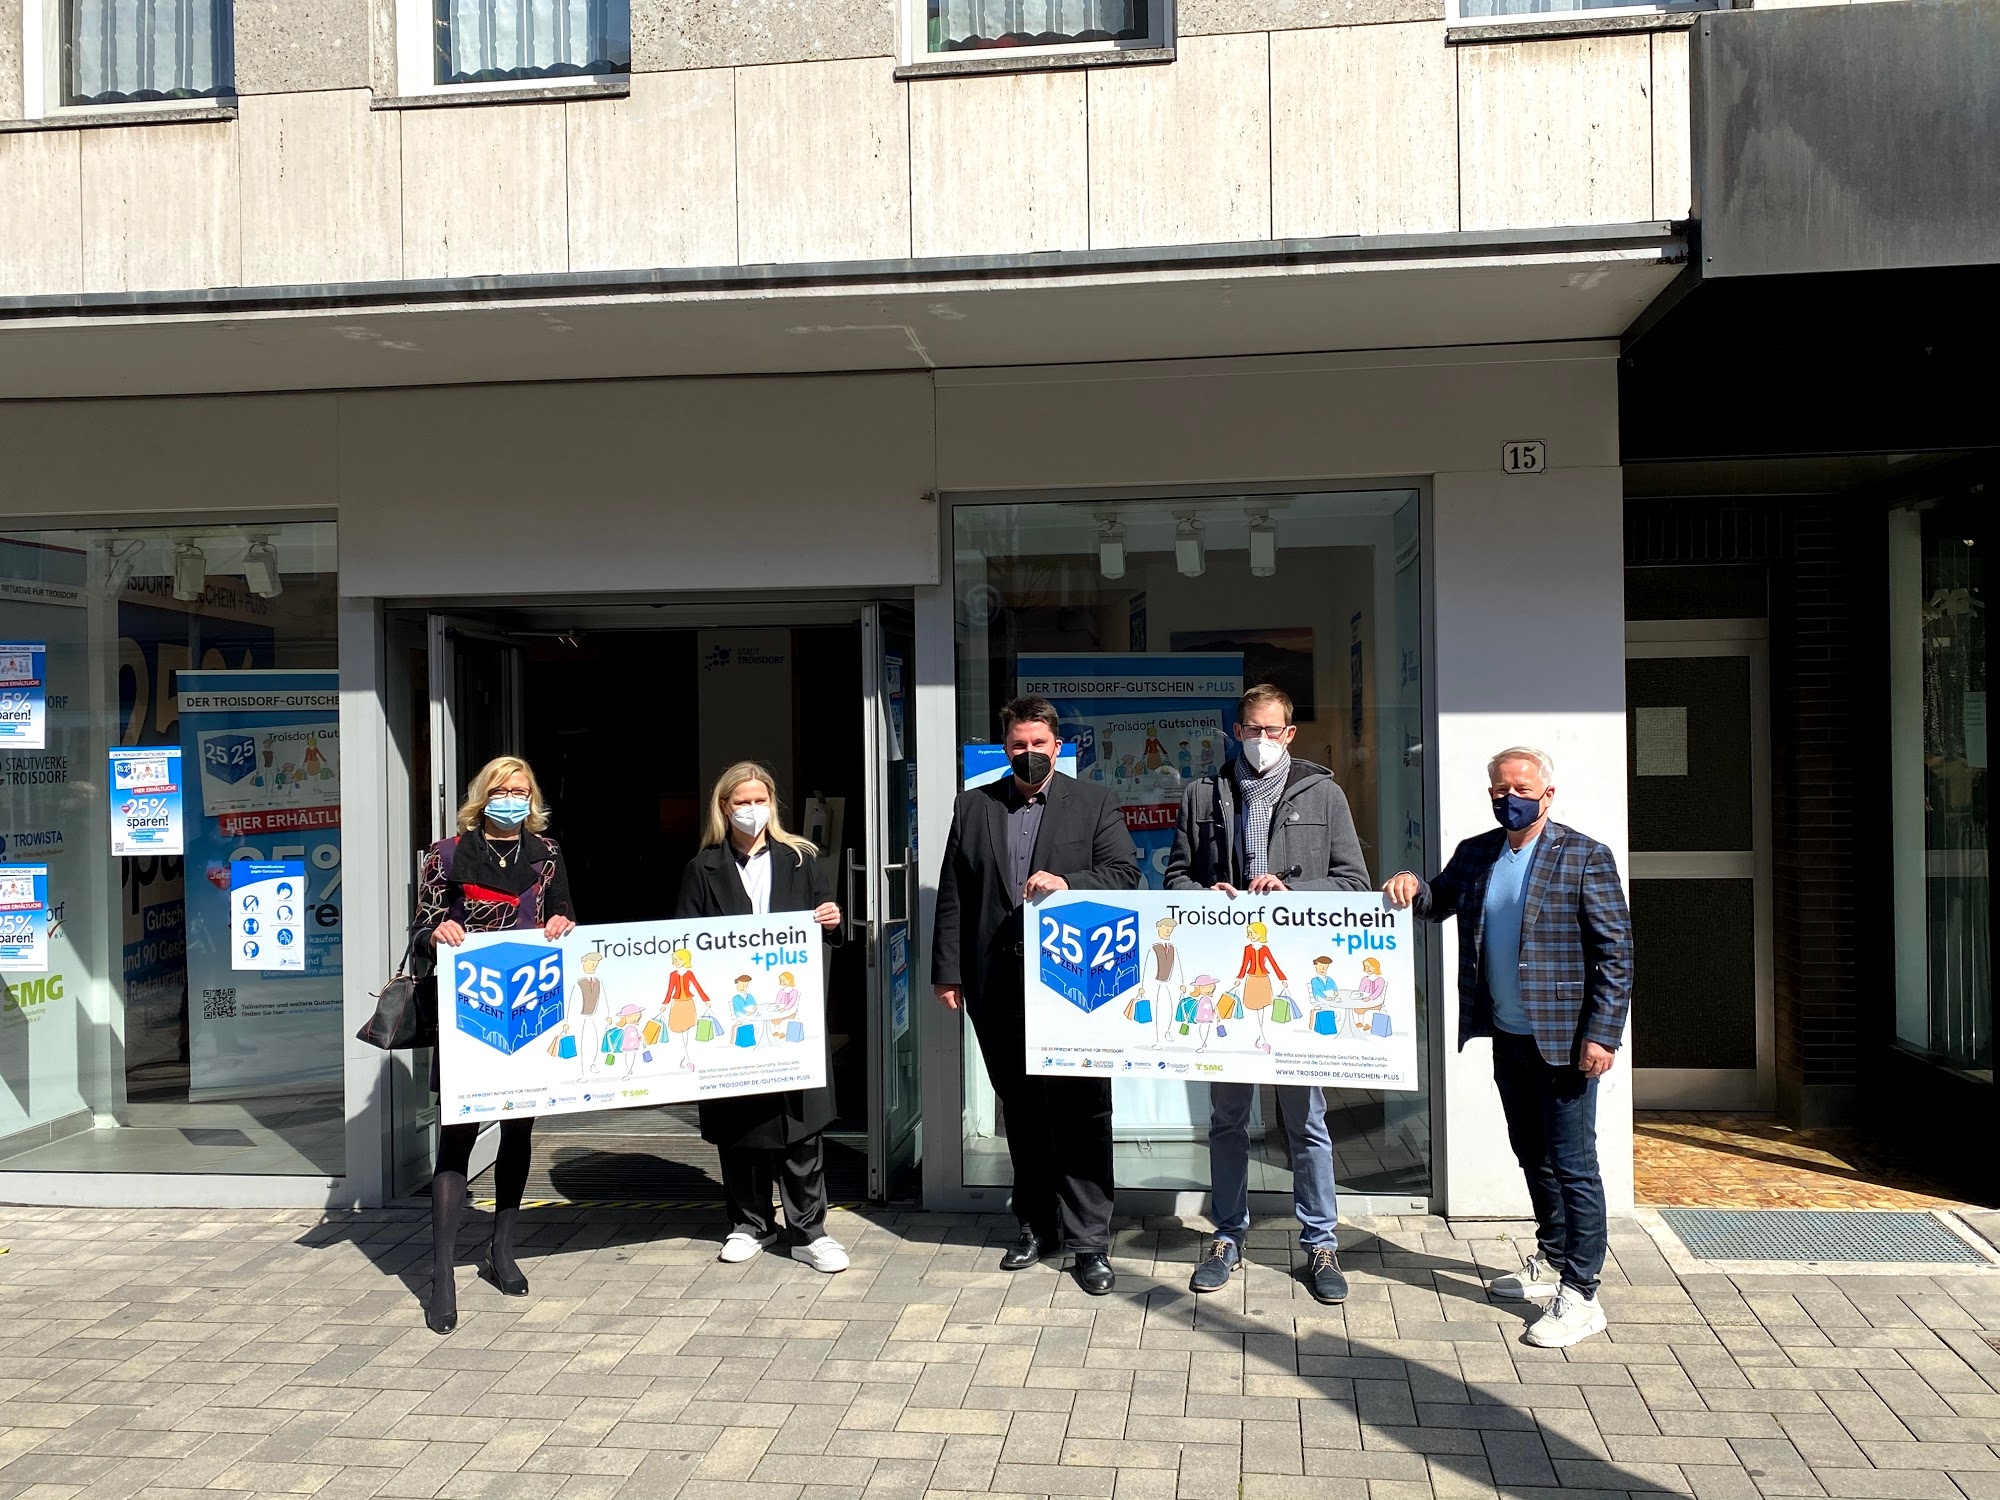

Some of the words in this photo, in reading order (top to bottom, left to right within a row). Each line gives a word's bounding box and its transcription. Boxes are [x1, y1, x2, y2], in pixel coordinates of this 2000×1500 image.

[1510, 446, 1536, 469] 15
[1, 584, 31, 595] INITIATIVE
[33, 586, 44, 596] FÜR
[45, 589, 78, 600] TROISDORF
[737, 656, 784, 665] TROISDORF
[1026, 682, 1050, 693] DER
[1052, 681, 1194, 693] TROISDORF-GUTSCHEIN
[0, 692, 32, 711] 5%
[187, 697, 210, 707] DER
[1107, 719, 1156, 732] Troisdorf
[1158, 717, 1217, 730] Gutschein
[267, 731, 315, 742] Troisdorf
[318, 729, 339, 739] Gut
[205, 743, 228, 764] 25
[231, 739, 254, 764] 25
[5, 756, 68, 771] STADTWERKE
[6, 770, 68, 786] TROISDORF
[126, 797, 169, 818] 25%
[1123, 807, 1179, 826] HÄLTL
[126, 816, 169, 830] sparen!
[226, 818, 262, 831] HIER
[266, 810, 340, 828] ERHÄLTLI
[13, 831, 63, 847] TROWISTA
[1166, 905, 1266, 926] Troisdorf
[1272, 906, 1395, 928] Gutschein
[309, 935, 340, 943] kaufen
[591, 933, 690, 958] Troisdorf
[695, 925, 807, 951] Gutschein
[1041, 916, 1084, 964] 25
[1090, 916, 1137, 968] 25
[1331, 929, 1397, 955] +plus
[143, 943, 157, 967] 90
[750, 946, 809, 972] +plus
[1041, 947, 1085, 978] PRZENT
[1090, 948, 1137, 979] PRZENT
[457, 960, 504, 1007] 25
[510, 953, 561, 1010] 25
[3, 974, 64, 1012] SMG
[457, 993, 505, 1021] PRZENT
[511, 985, 562, 1021] PRZENT
[699, 1074, 810, 1090] WWW.TROISDORF.DE/GUTSCHEIN-PLUS
[1275, 1069, 1399, 1081] WWW.TROISDORF.DE/GUTSCHEIN-PLUS
